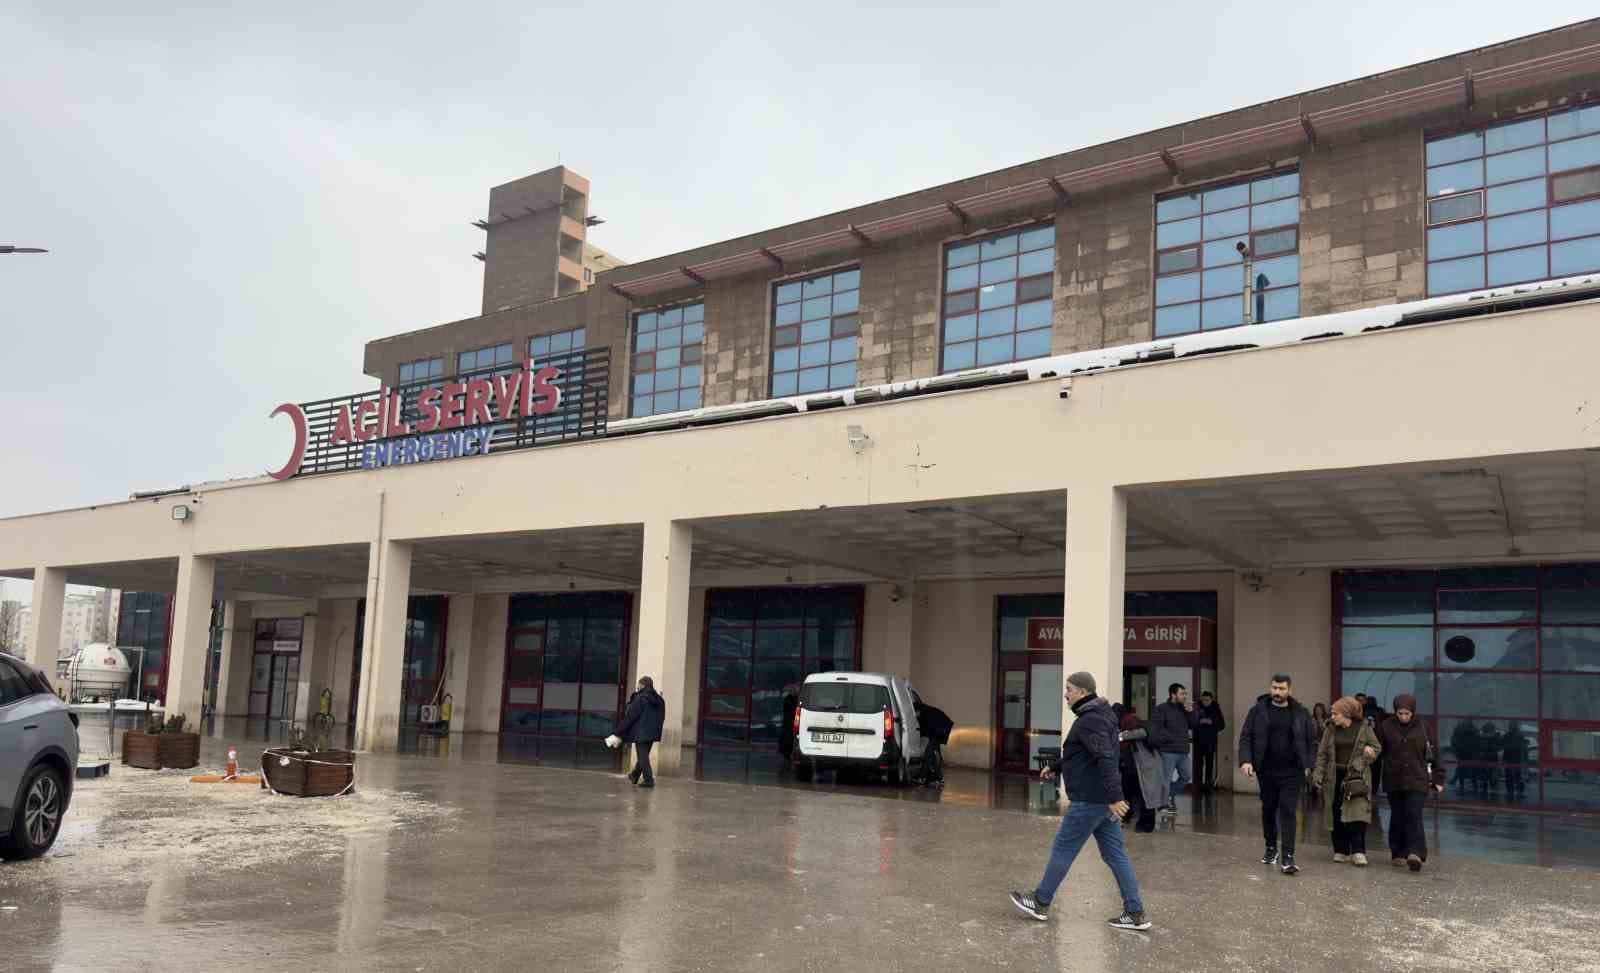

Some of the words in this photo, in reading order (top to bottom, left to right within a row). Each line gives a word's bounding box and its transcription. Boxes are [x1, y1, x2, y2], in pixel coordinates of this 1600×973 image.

[330, 383, 408, 445] ACİL
[416, 358, 561, 431] SERVİS
[361, 428, 493, 469] EMERGENCY
[1038, 627, 1063, 640] AYA
[1145, 624, 1187, 645] GİRİŞİ
